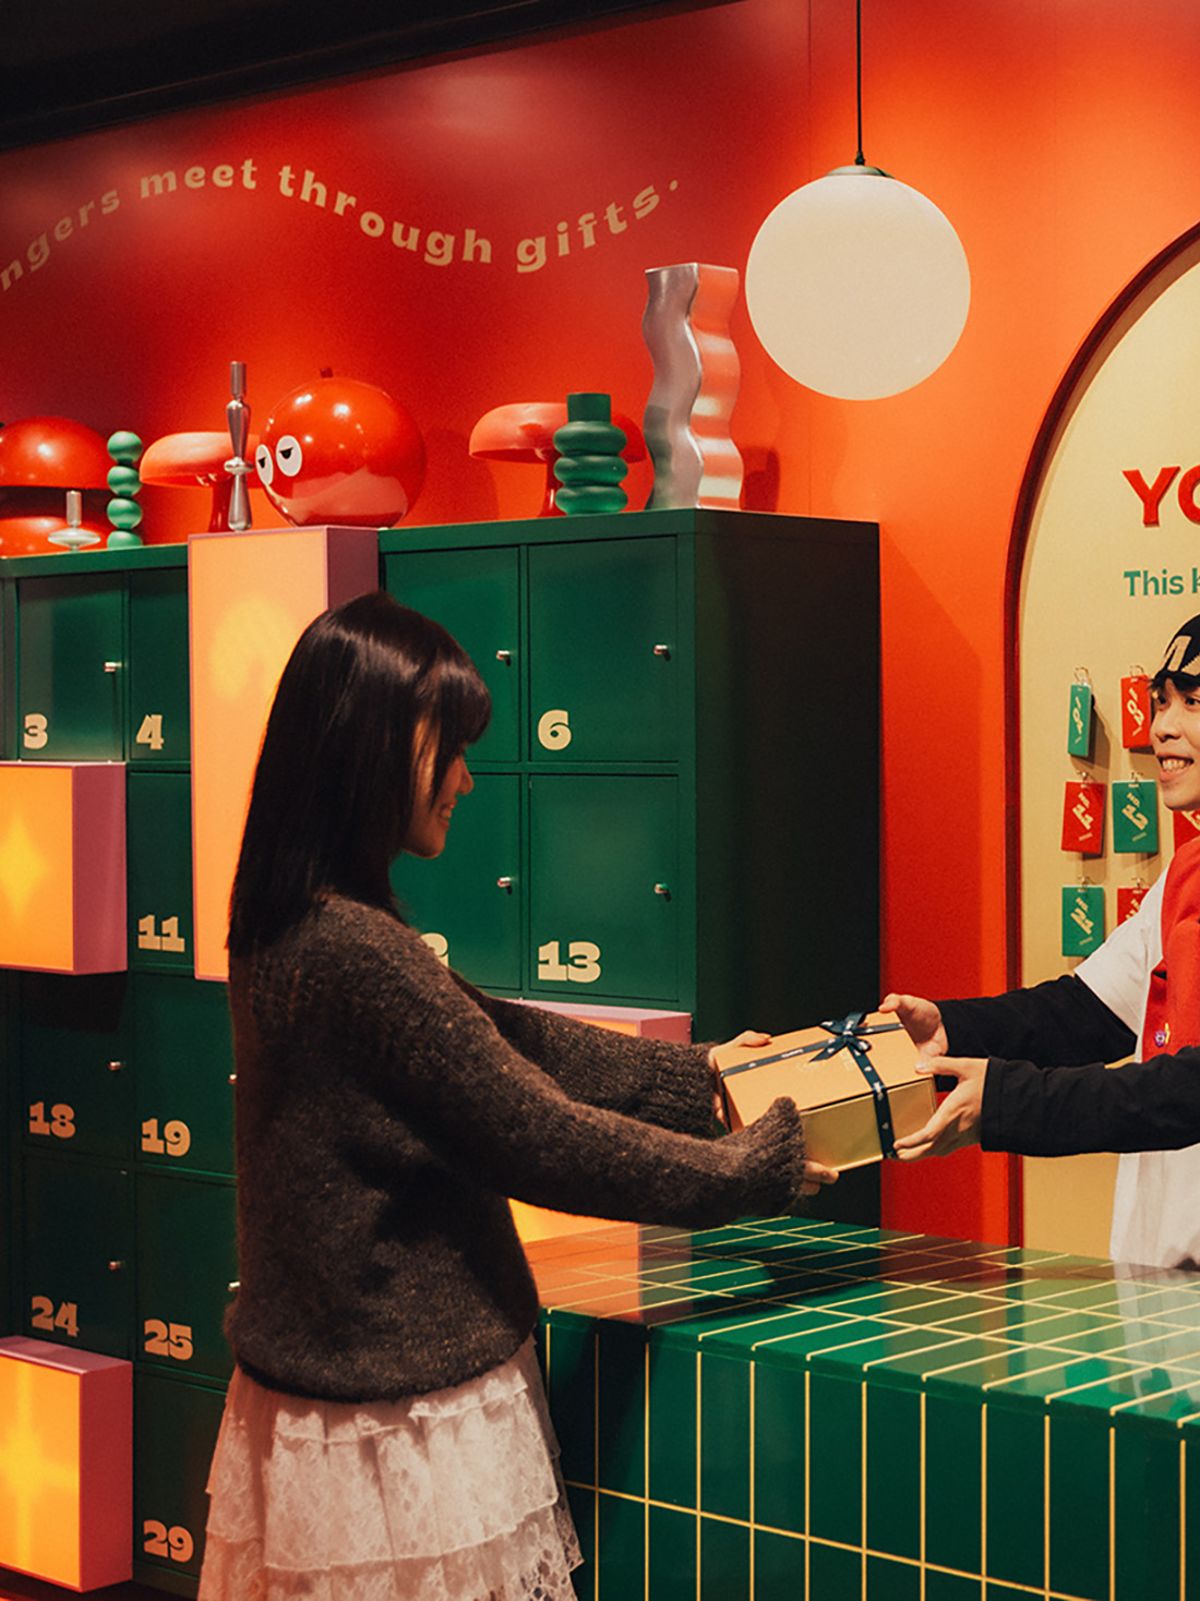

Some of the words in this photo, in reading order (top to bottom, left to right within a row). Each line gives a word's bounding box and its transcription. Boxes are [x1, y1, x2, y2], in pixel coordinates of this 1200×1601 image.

[140, 159, 257, 199] meet
[279, 165, 492, 266] through
[517, 180, 679, 273] gifts.
[1123, 566, 1184, 597] This
[538, 709, 572, 751] 6
[1127, 699, 1144, 726] 02
[23, 714, 48, 750] 3
[136, 715, 165, 750] 4
[1072, 804, 1094, 830] 11
[1121, 804, 1149, 830] 12
[139, 914, 185, 953] 11
[1070, 908, 1094, 935] 21
[538, 940, 601, 983] 13
[29, 1101, 76, 1139] 18
[141, 1118, 191, 1157] 19
[30, 1296, 79, 1338] 24
[144, 1319, 193, 1361] 25
[143, 1519, 194, 1563] 29
